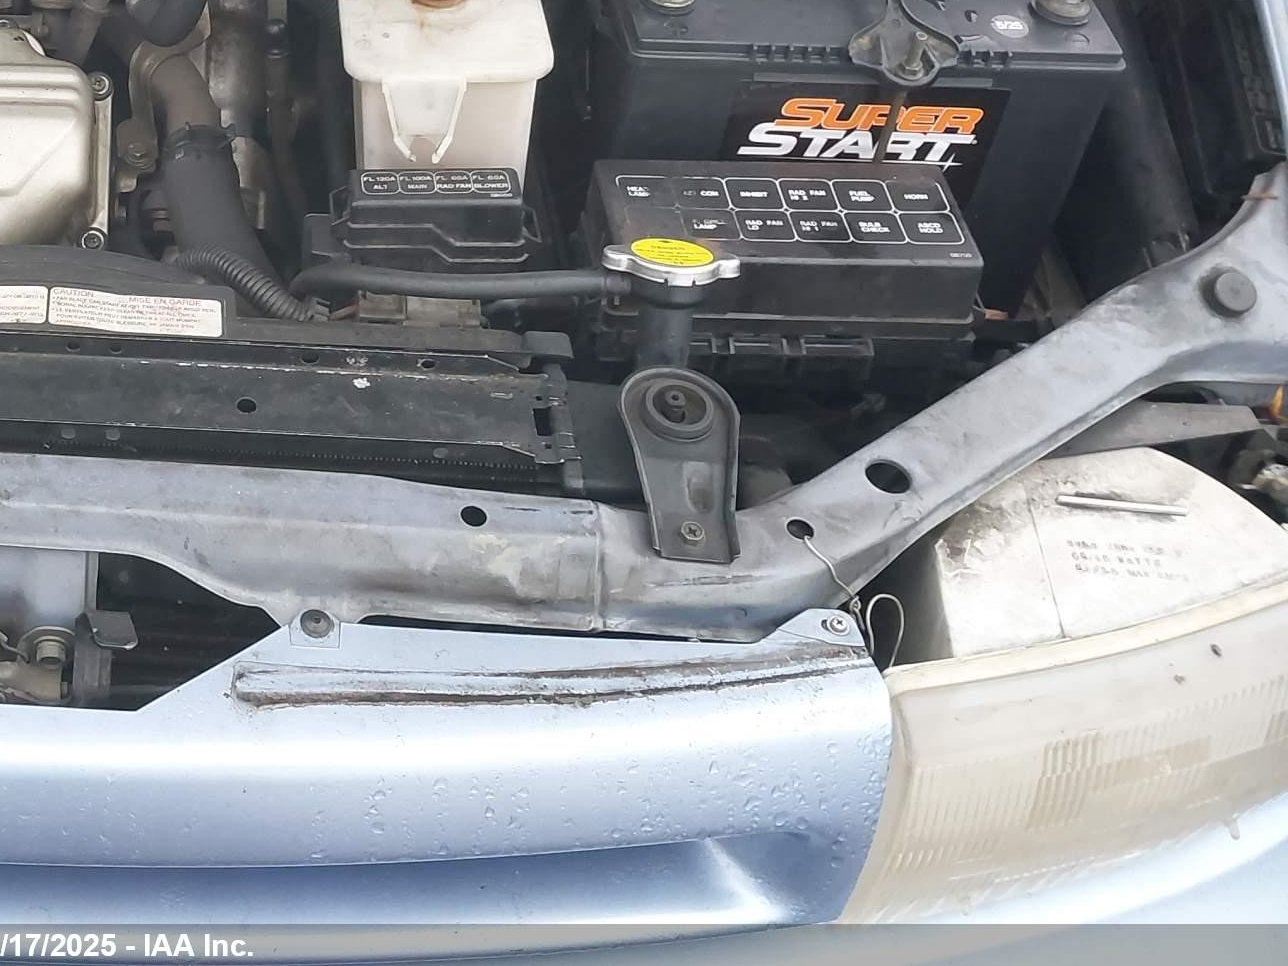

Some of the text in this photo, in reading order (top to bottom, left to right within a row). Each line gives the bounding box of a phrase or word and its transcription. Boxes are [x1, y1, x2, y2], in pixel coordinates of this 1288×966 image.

[774, 97, 984, 133] SUPER
[736, 121, 975, 163] START
[53, 289, 94, 298] CAUTION
[128, 296, 151, 304] MISE
[168, 298, 201, 307] GARDE
